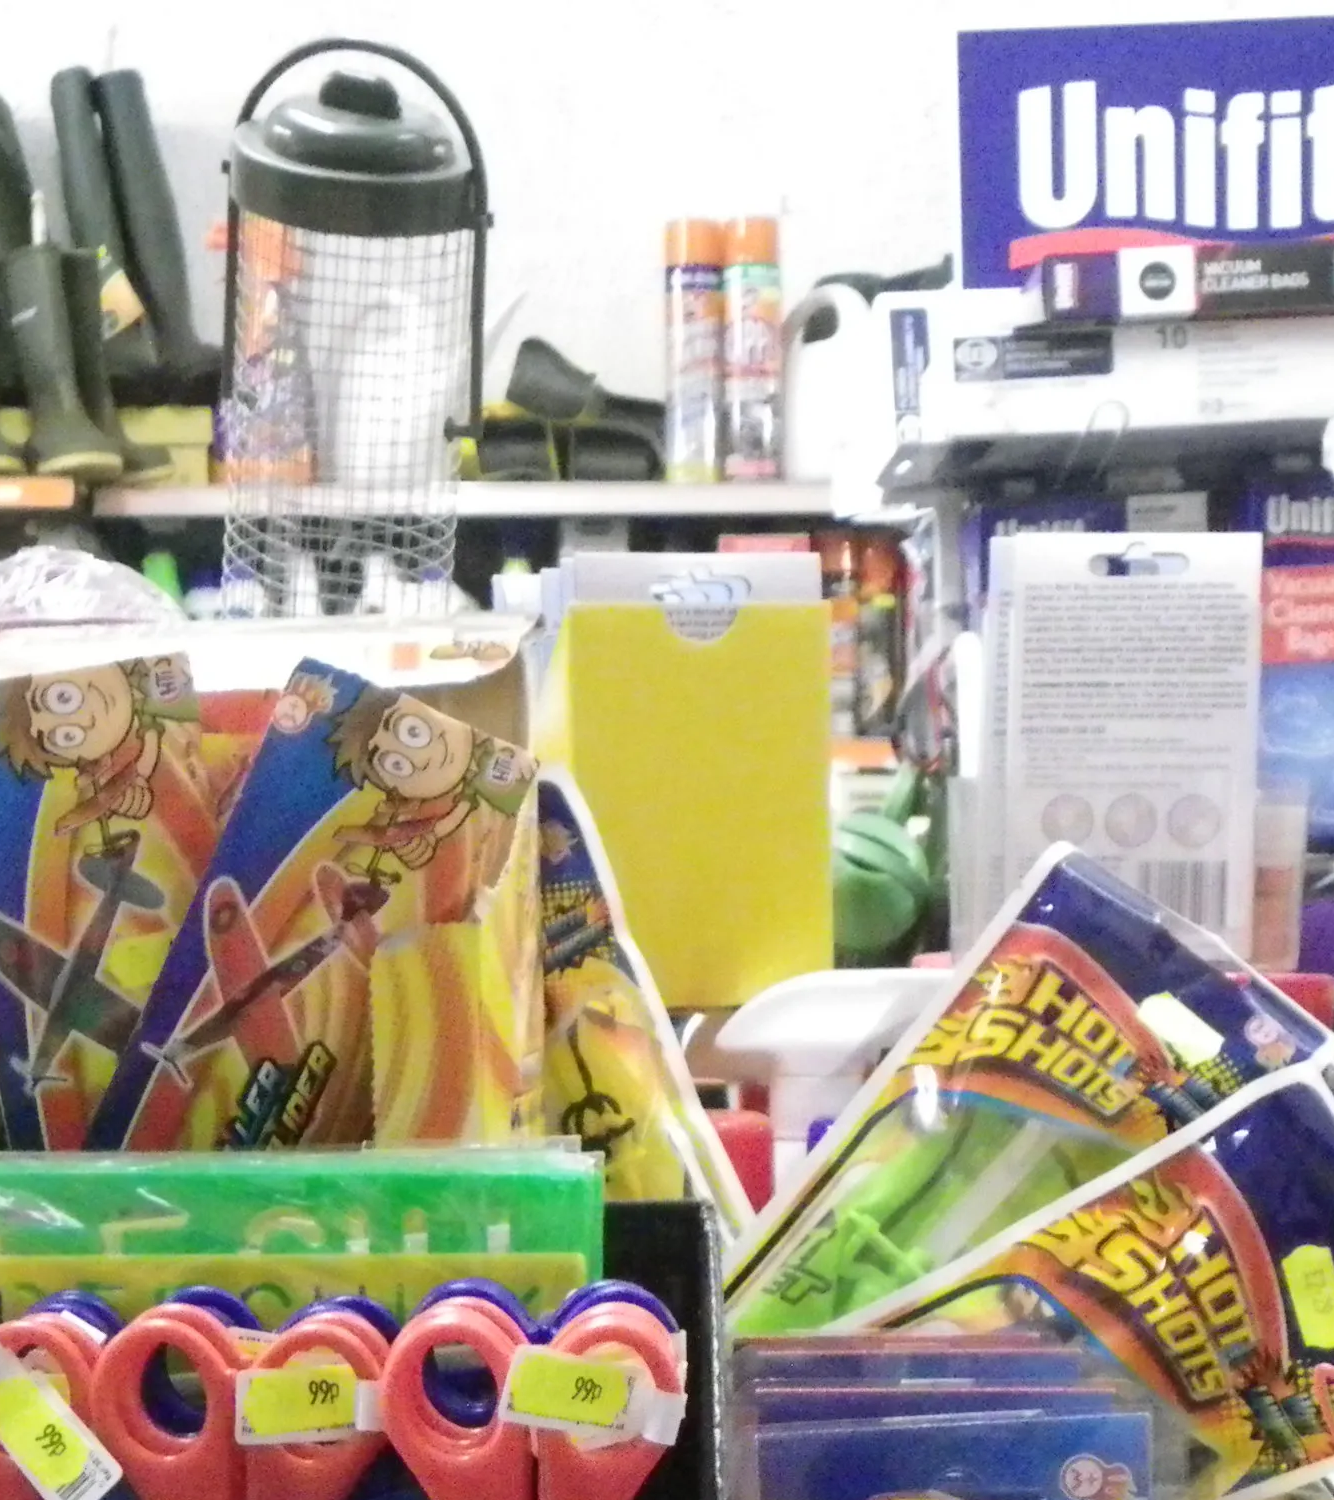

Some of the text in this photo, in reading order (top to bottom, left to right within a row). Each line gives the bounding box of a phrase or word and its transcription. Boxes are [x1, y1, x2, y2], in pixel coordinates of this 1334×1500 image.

[966, 1007, 1127, 1112] SHOTS
[1025, 969, 1140, 1069] HOT
[1076, 1232, 1225, 1394] SHOTS
[1170, 1216, 1253, 1348] HOT
[308, 1379, 340, 1405] 99p
[571, 1375, 603, 1403] 99p
[35, 1423, 67, 1458] 99p
